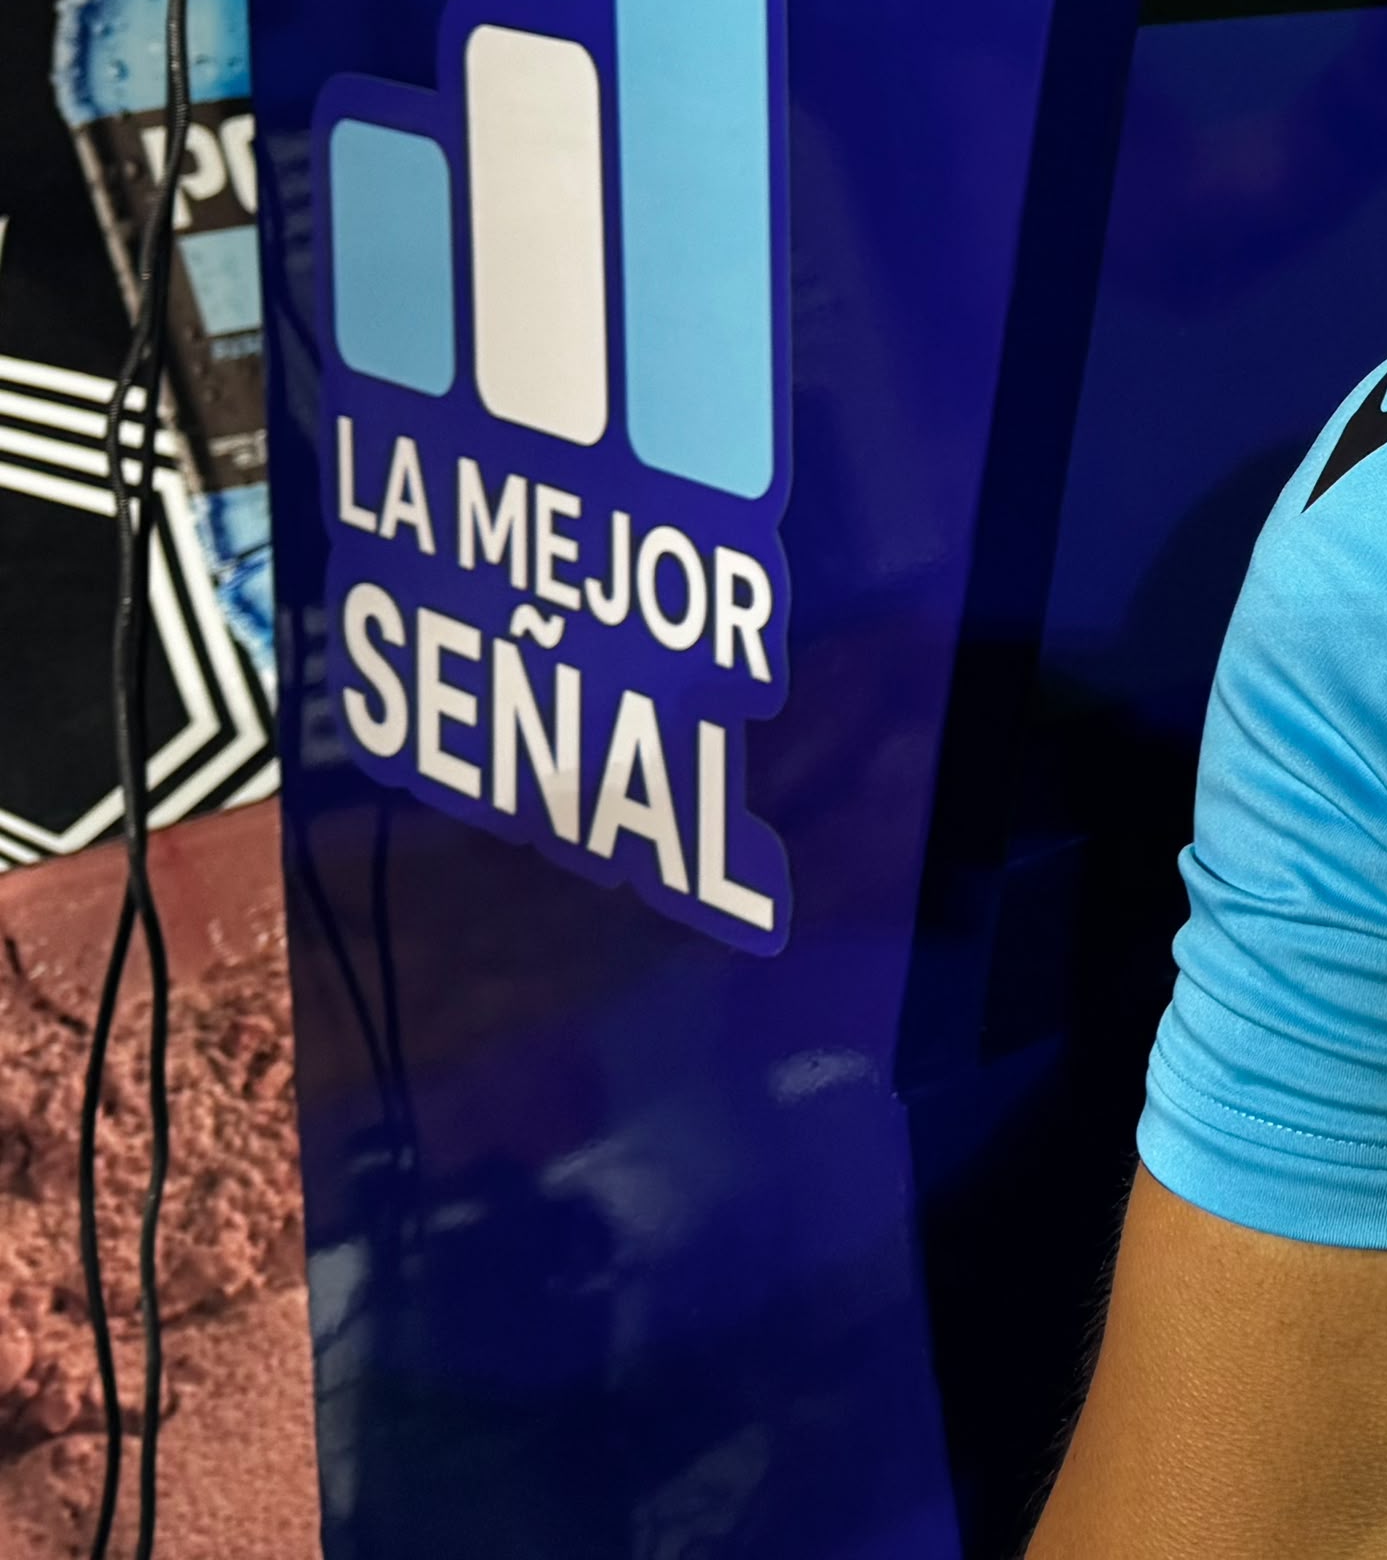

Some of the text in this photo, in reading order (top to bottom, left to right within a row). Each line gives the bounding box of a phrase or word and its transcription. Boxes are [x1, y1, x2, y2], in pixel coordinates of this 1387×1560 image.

[337, 415, 772, 684] LA MEJOR
[343, 581, 775, 933] SEÑAL
